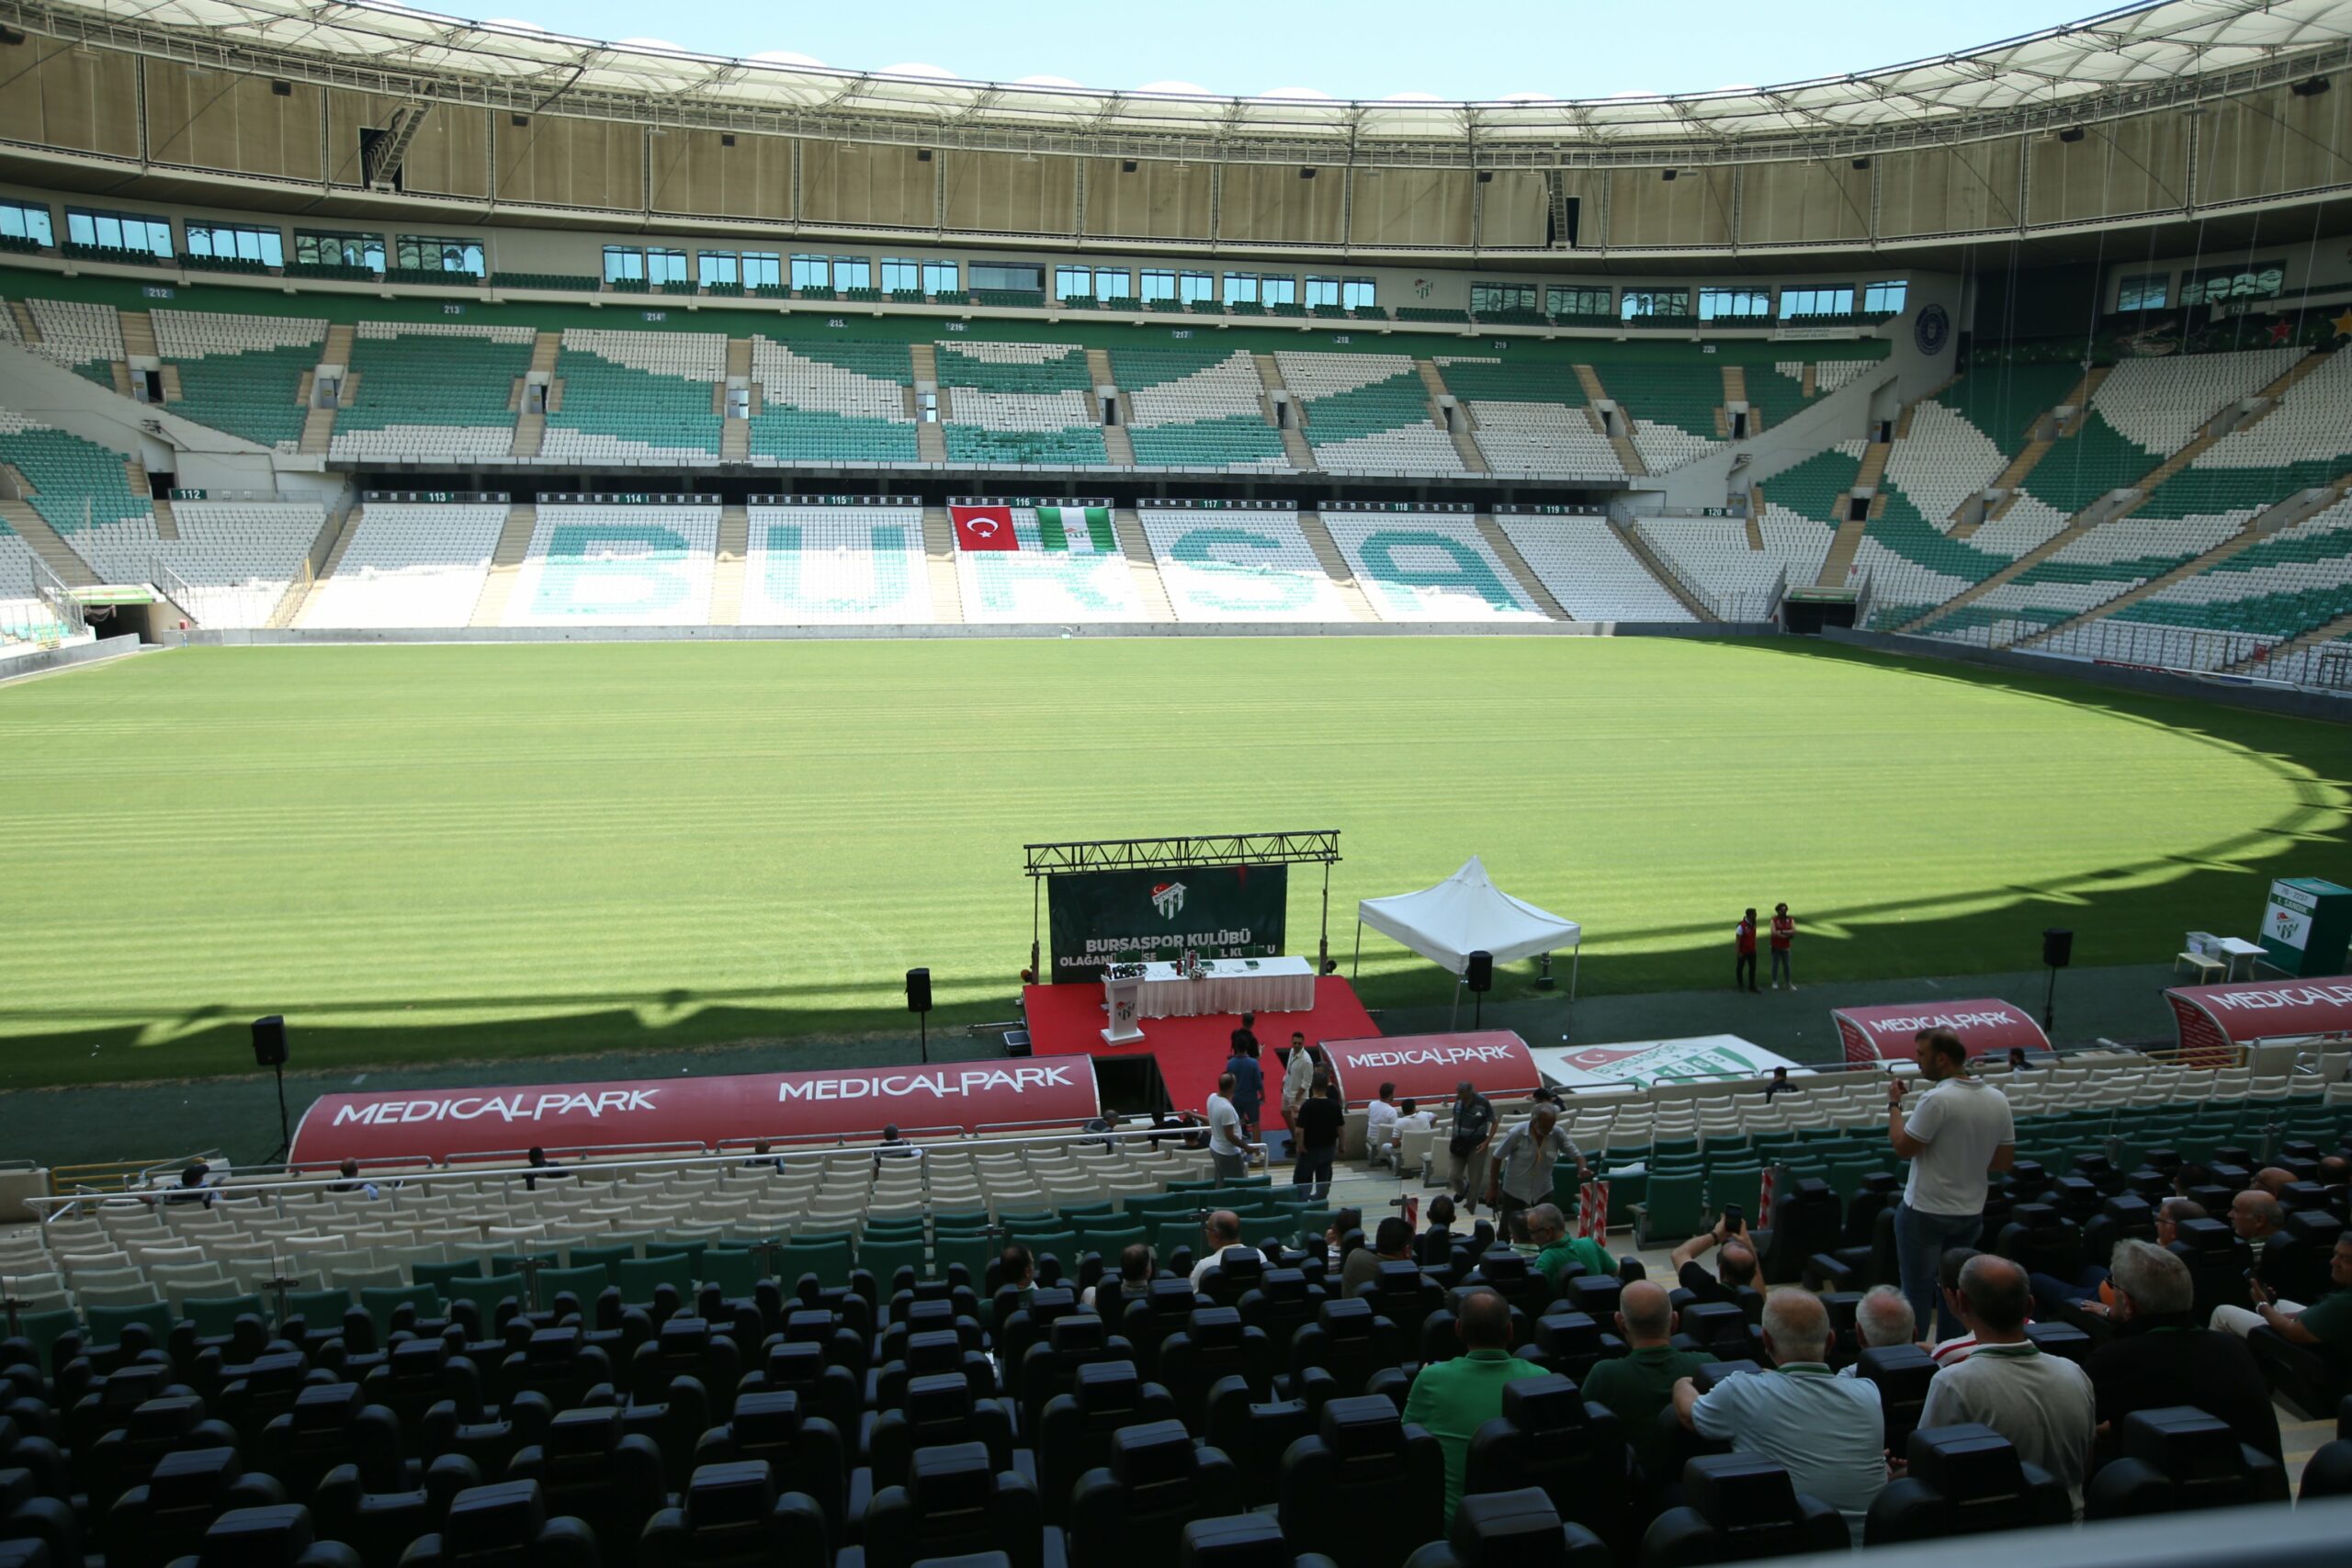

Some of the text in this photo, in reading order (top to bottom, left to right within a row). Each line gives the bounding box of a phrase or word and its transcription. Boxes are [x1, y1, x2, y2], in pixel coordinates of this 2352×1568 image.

[150, 288, 167, 298] 212
[444, 305, 460, 313] 213
[647, 312, 661, 321] 214
[830, 319, 843, 327] 215
[1495, 341, 1507, 349] 219
[181, 490, 200, 499] 112
[429, 492, 447, 502] 113
[626, 494, 641, 503] 114
[832, 496, 847, 504] 115
[1204, 500, 1217, 508] 117
[1396, 502, 1408, 511] 118
[1708, 508, 1722, 516] 120
[1086, 935, 1183, 953] BURSASPOR
[1187, 928, 1251, 946] KULÜBÜ
[1059, 953, 1116, 966] OLAĞANÜ
[2207, 986, 2352, 1010] MEDICALP
